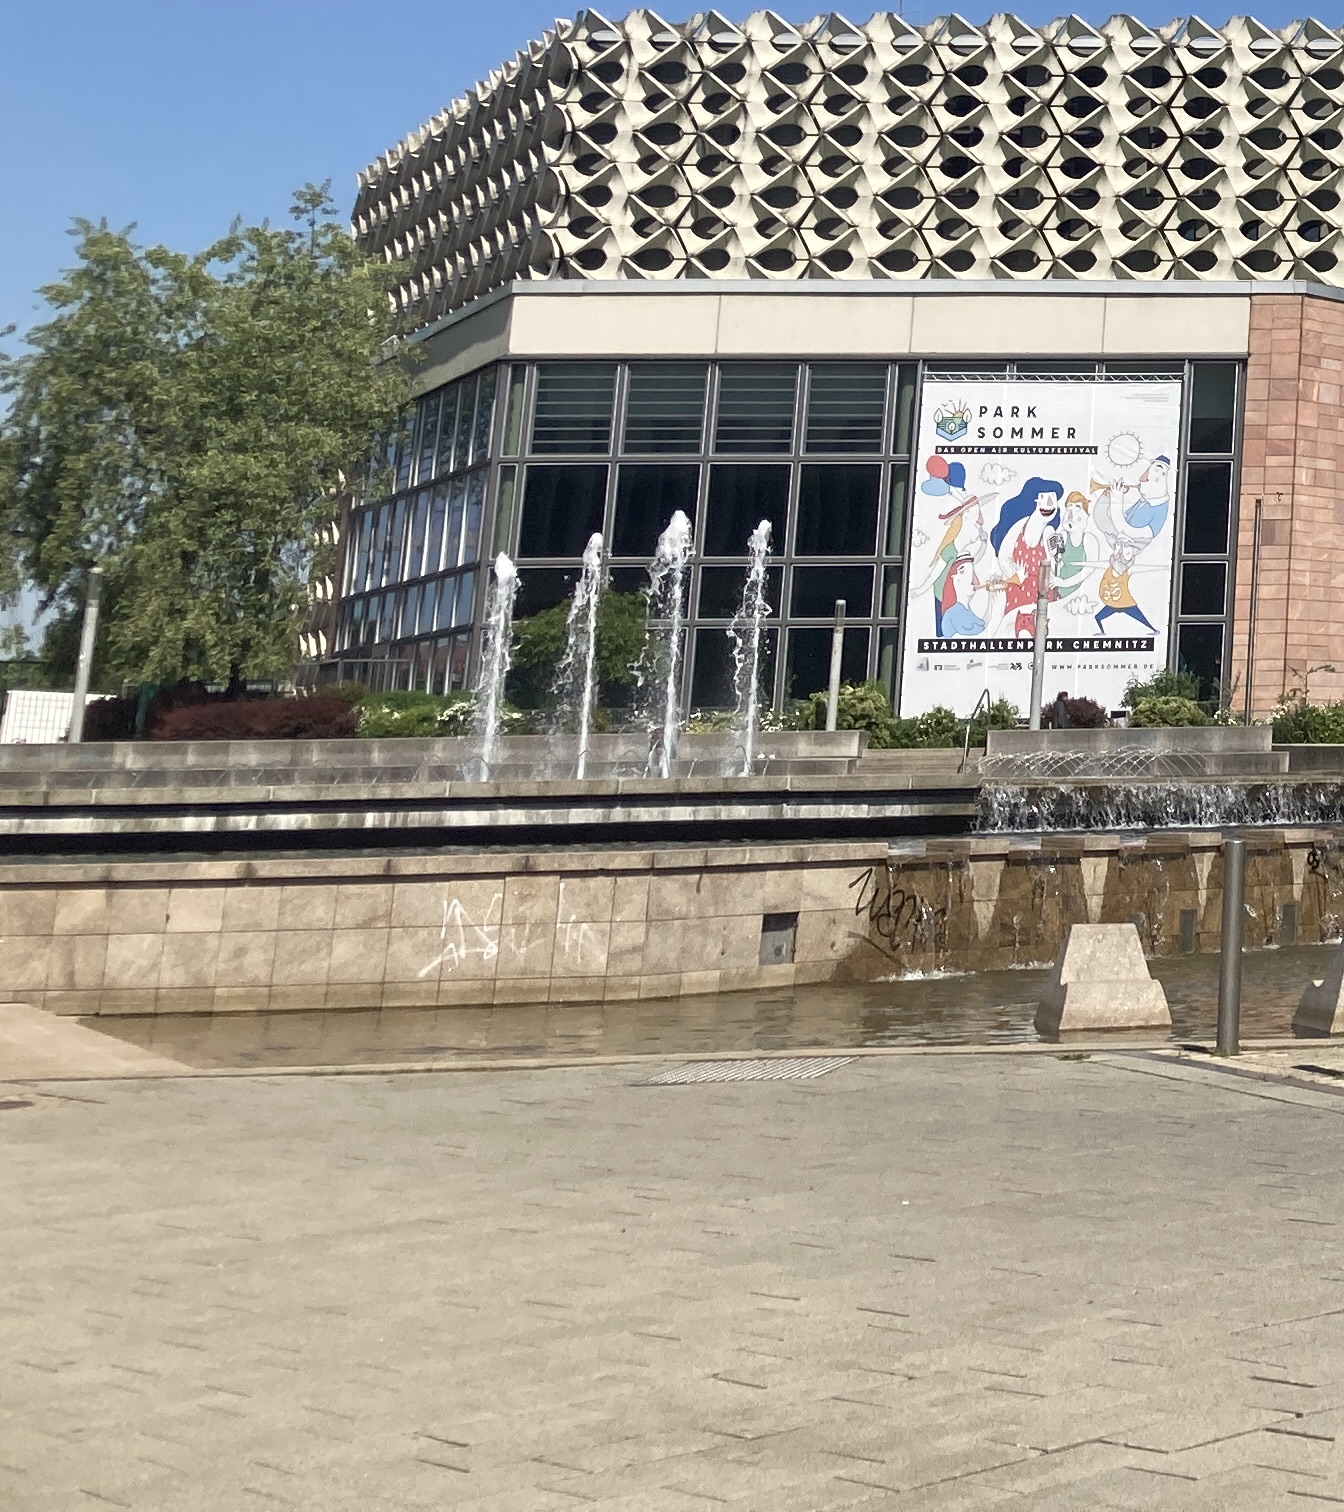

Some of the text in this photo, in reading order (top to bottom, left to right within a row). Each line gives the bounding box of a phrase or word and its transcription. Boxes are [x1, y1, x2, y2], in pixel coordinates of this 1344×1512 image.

[978, 405, 1038, 418] PARK
[977, 426, 1077, 439] SOMMER
[936, 446, 1097, 454] DAS OPEN AIR KULTURFESTIVAL
[923, 639, 1148, 651] STADTHALLENPRK CHEMNITZ
